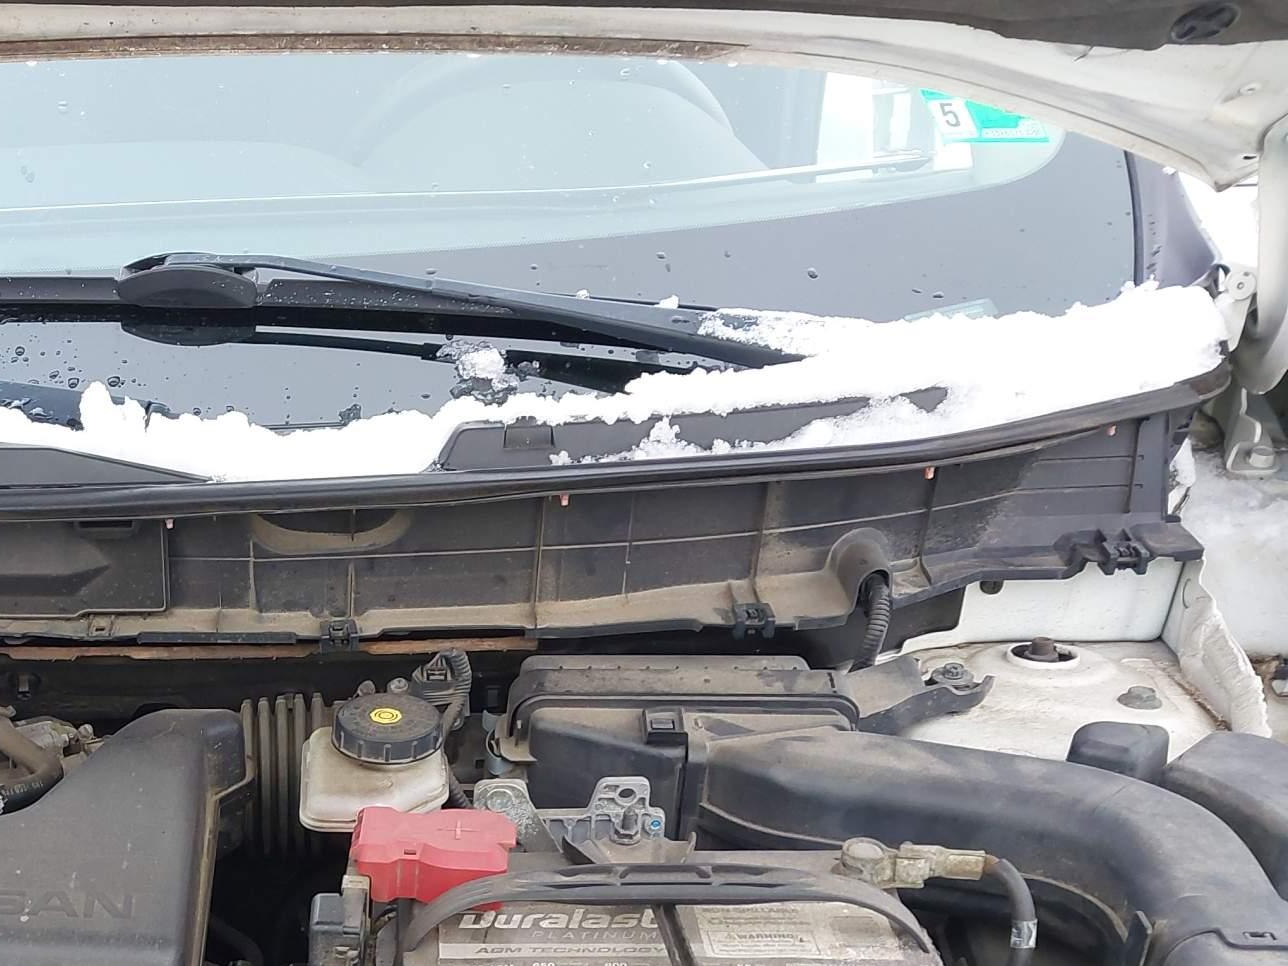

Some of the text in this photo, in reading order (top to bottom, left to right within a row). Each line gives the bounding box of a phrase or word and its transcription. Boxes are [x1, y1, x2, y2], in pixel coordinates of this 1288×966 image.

[940, 103, 960, 127] 5
[458, 908, 659, 930] Duralast
[531, 930, 658, 940] PLATINUM
[475, 946, 665, 954] AGM TECHNOLOGY
